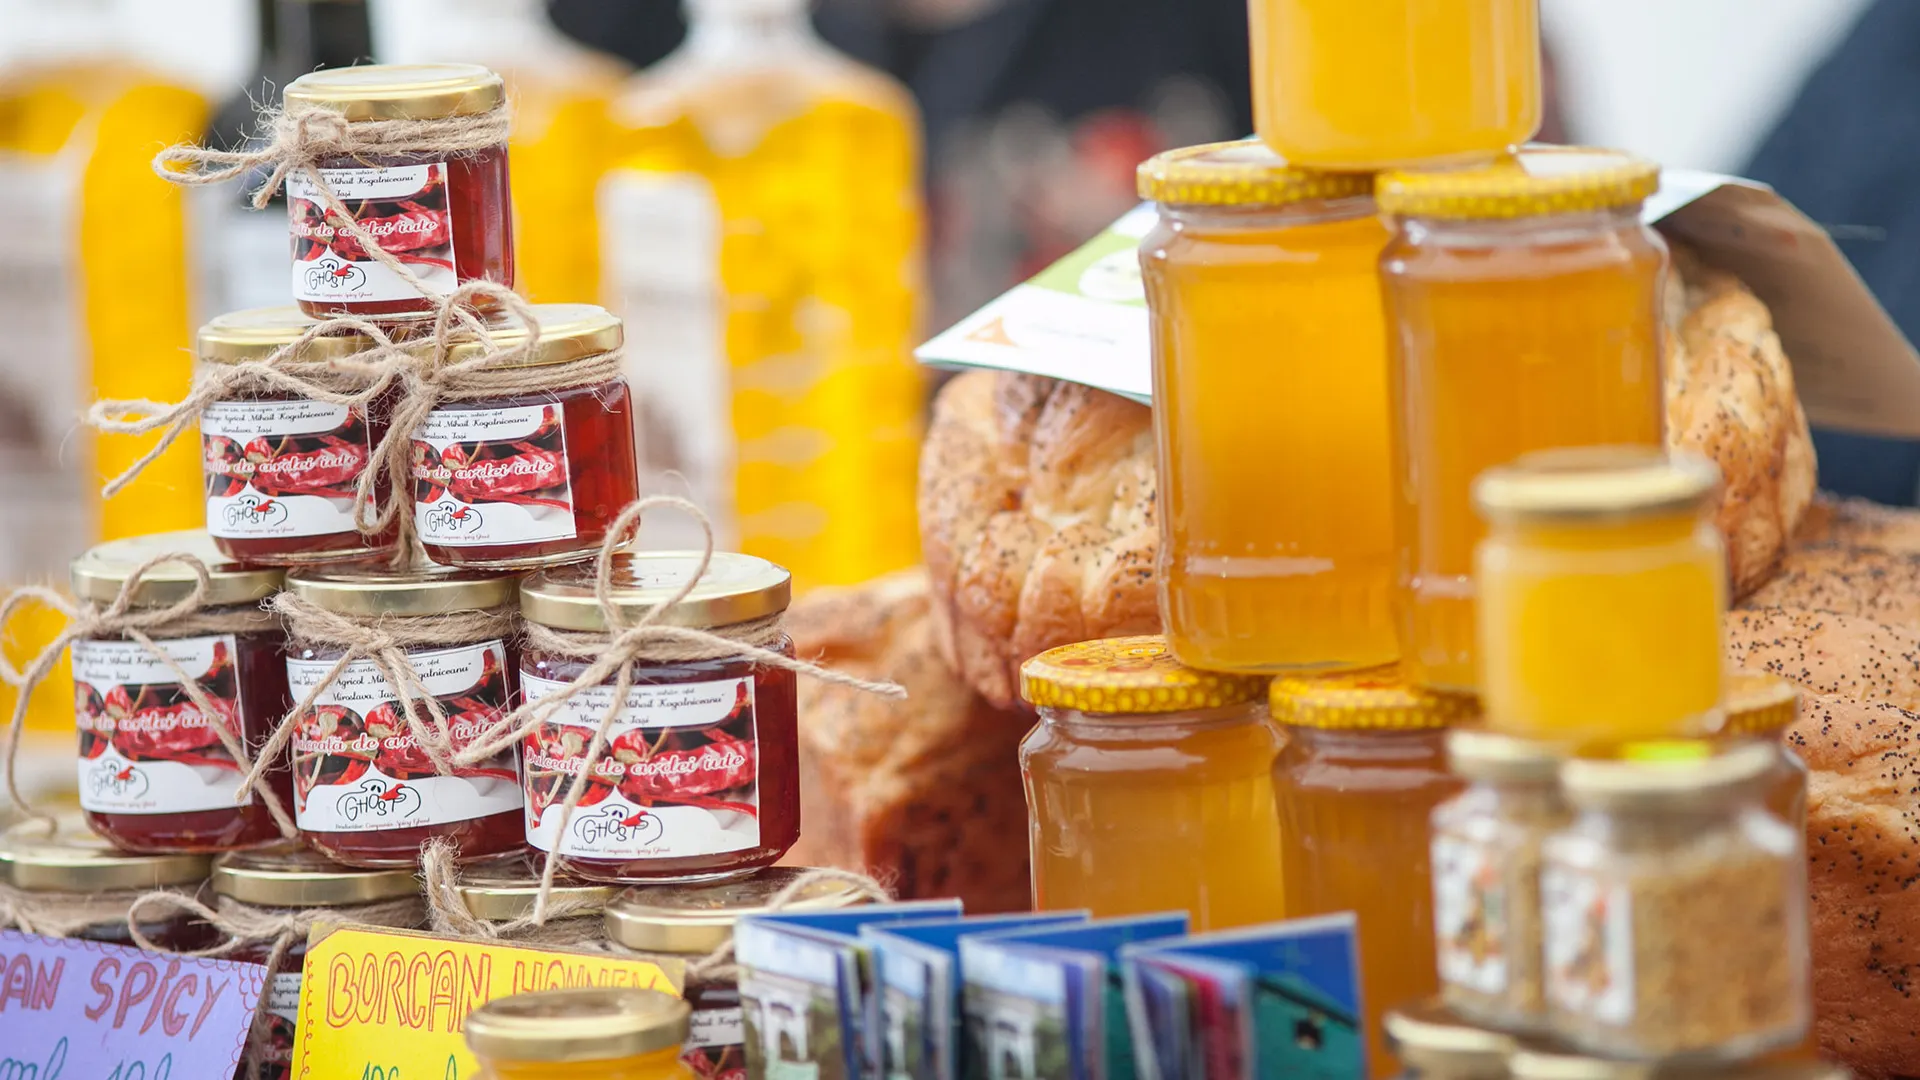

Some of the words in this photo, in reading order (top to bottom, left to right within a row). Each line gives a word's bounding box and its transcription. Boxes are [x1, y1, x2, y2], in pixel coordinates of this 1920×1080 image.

[314, 222, 335, 236] de
[398, 220, 438, 234] iute
[308, 268, 355, 290] GHOST
[233, 458, 254, 474] de
[259, 456, 316, 474] ardei
[320, 455, 358, 470] iute
[432, 464, 451, 479] de
[455, 462, 509, 479] ardei
[514, 461, 554, 476] iute
[227, 505, 275, 526] GHOST
[429, 512, 471, 532] GHOST
[335, 676, 364, 689] Agricol
[352, 732, 379, 750] de
[595, 756, 626, 776] de
[630, 753, 697, 776] ardei
[703, 753, 745, 772] iute
[345, 793, 407, 821] GHOST
[582, 817, 649, 844] GHOST
[0, 953, 66, 1014] AN
[325, 949, 492, 1035] BORCAN
